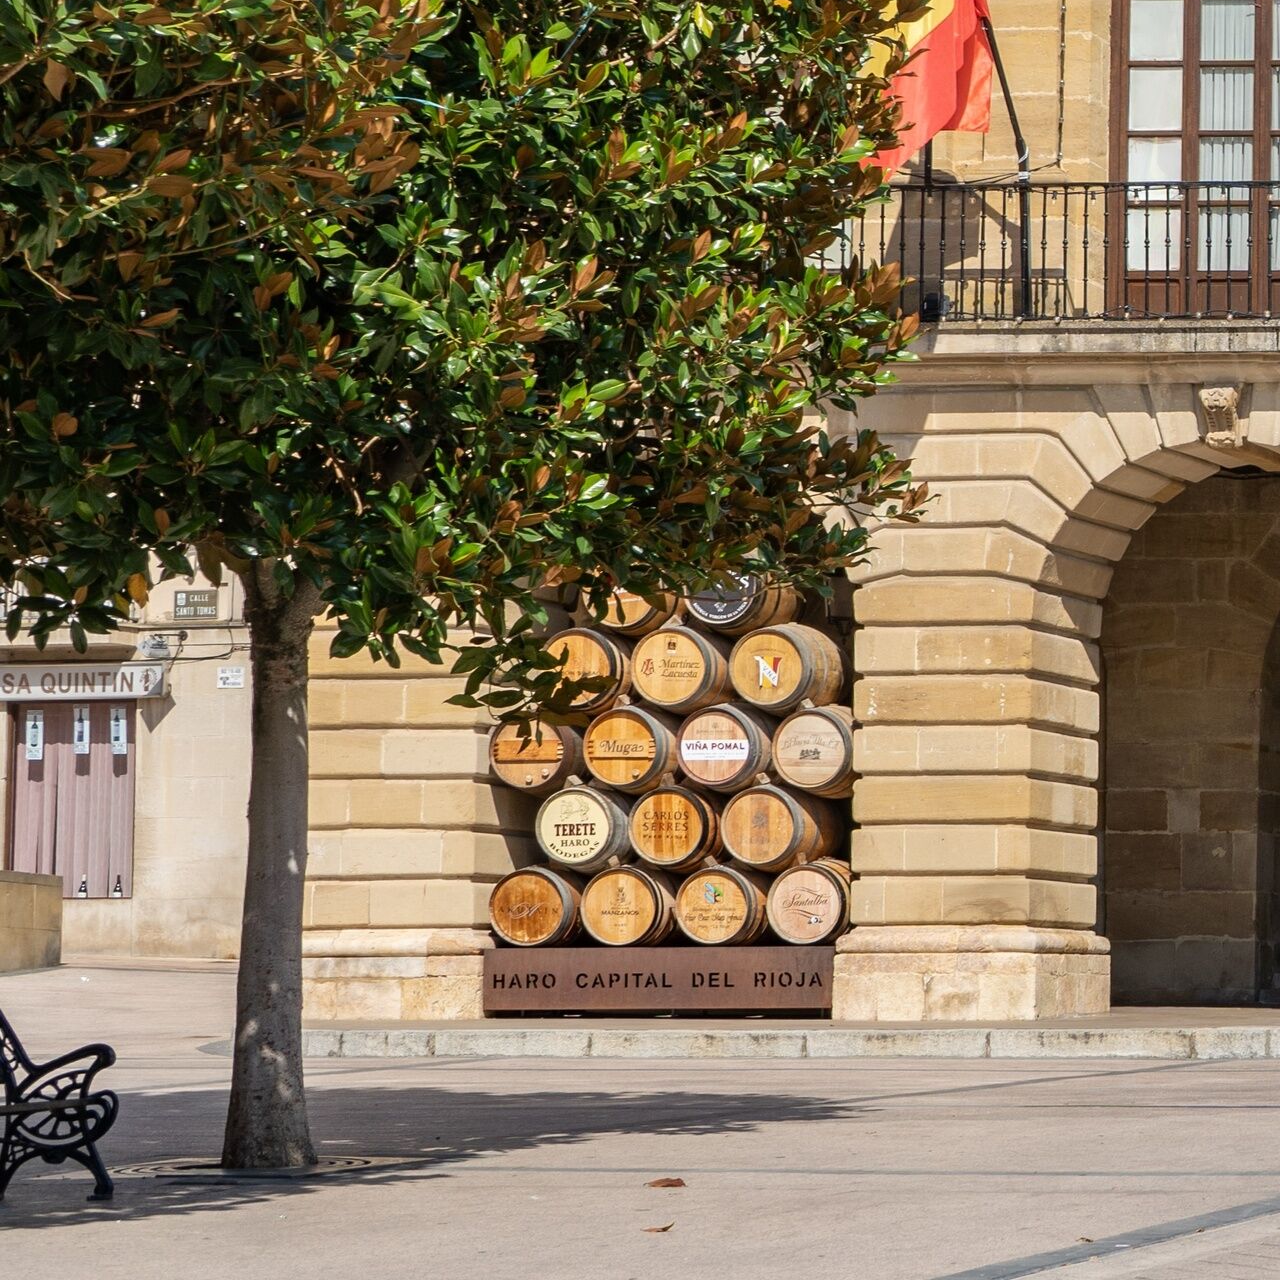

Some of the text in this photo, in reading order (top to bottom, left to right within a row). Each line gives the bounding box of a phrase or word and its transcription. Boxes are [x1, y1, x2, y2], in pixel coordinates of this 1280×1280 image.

[189, 593, 209, 602] CALLE
[175, 607, 195, 616] SANTO
[599, 740, 645, 755] Muga
[685, 740, 745, 751] VIÑA POMAL
[643, 810, 690, 821] CARLOS
[554, 822, 597, 837] TERETE
[642, 821, 689, 832] SERRES
[560, 838, 590, 847] HARO
[549, 841, 600, 859] BODEGAS
[492, 971, 823, 990] HARO CAPITAL DEL RIOJA
